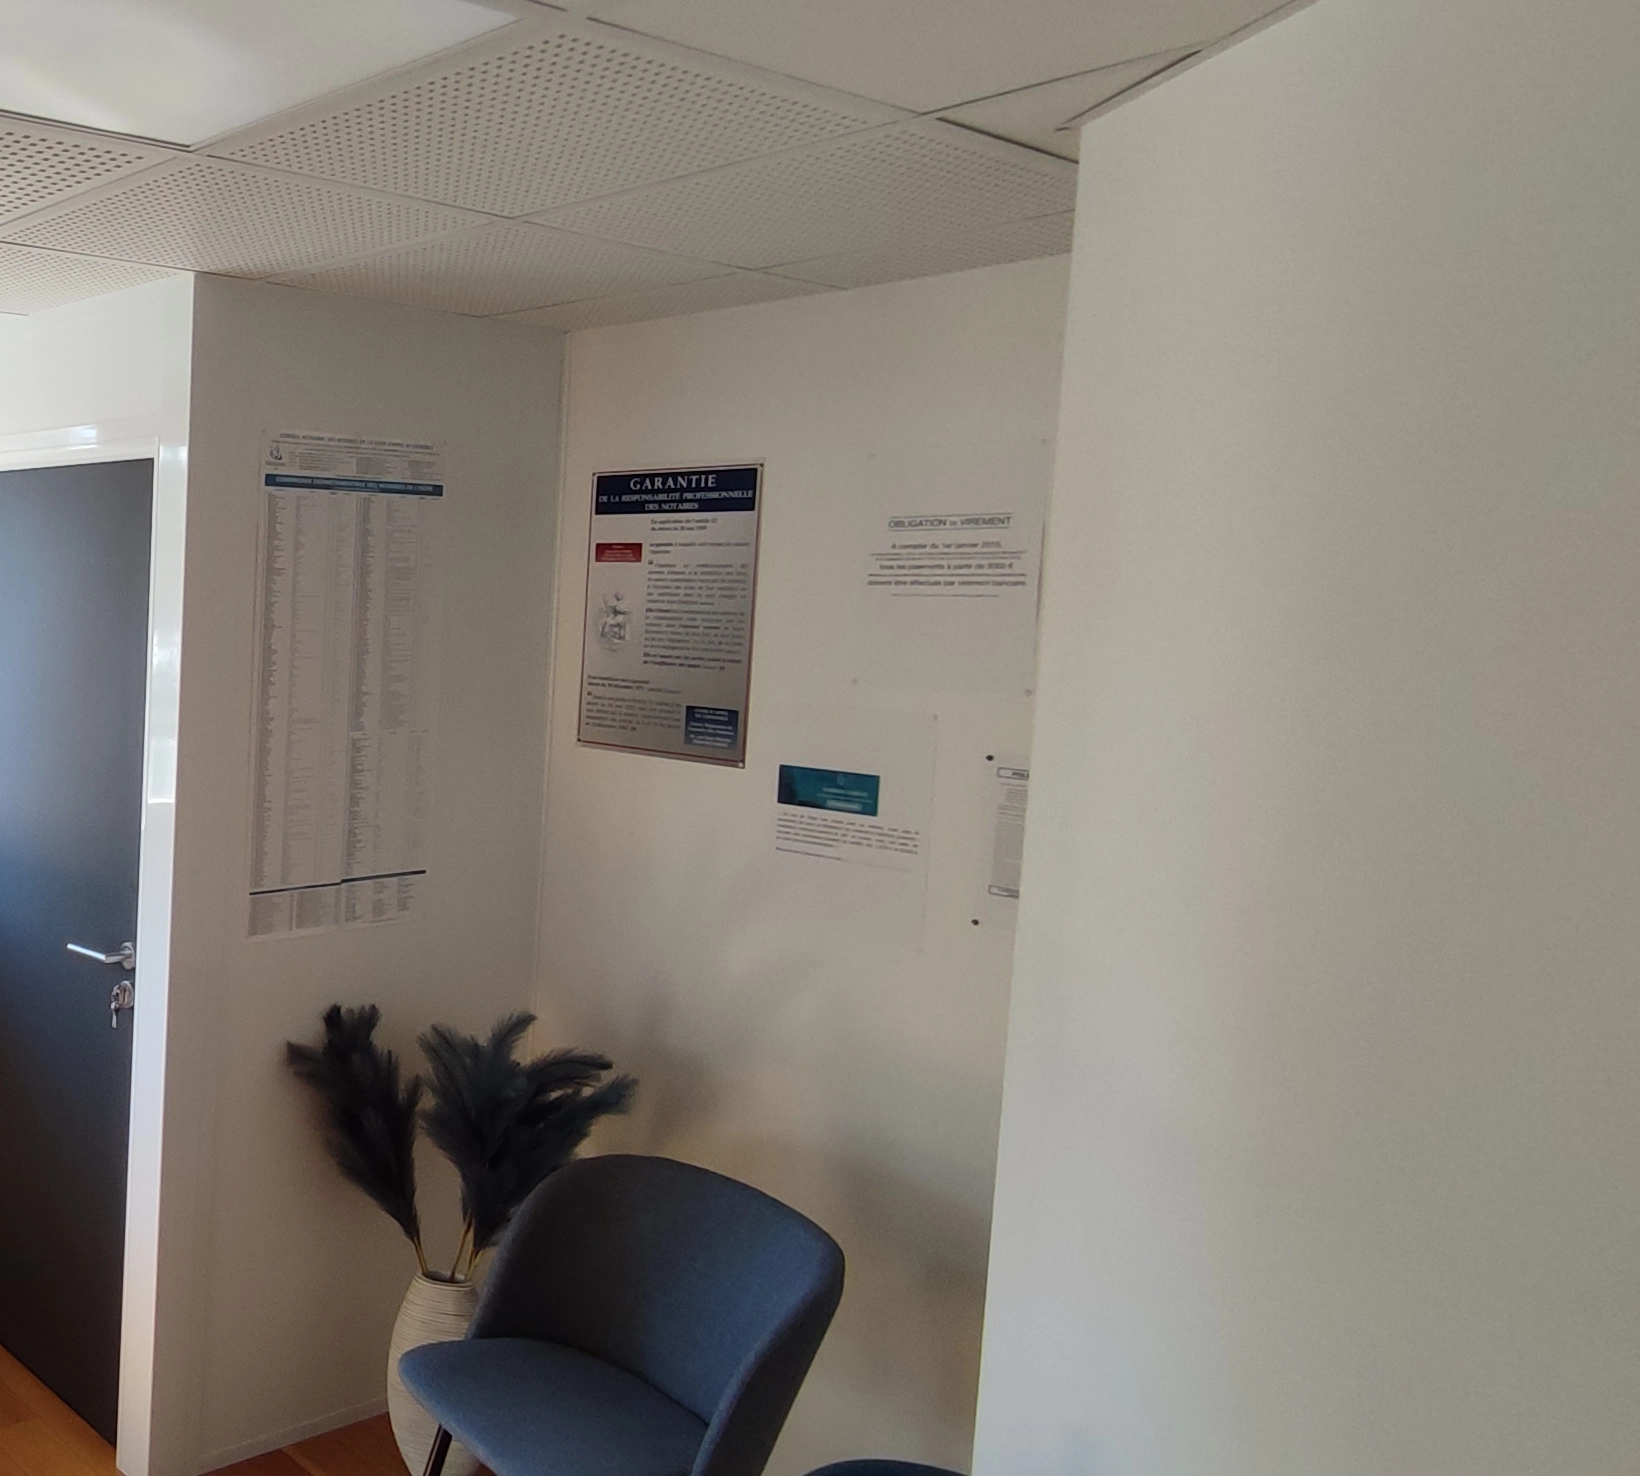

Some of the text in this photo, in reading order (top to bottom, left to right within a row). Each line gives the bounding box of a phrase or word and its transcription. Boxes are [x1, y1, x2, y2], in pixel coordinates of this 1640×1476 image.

[629, 474, 717, 490] GARANTIE
[598, 495, 608, 503] DE
[610, 495, 620, 503] LA
[682, 490, 753, 500] PROFESSIONNELLE
[644, 502, 700, 511] DES NOTAIRES
[888, 518, 947, 529] OBLIGATION
[960, 516, 1012, 526] VIREMENT
